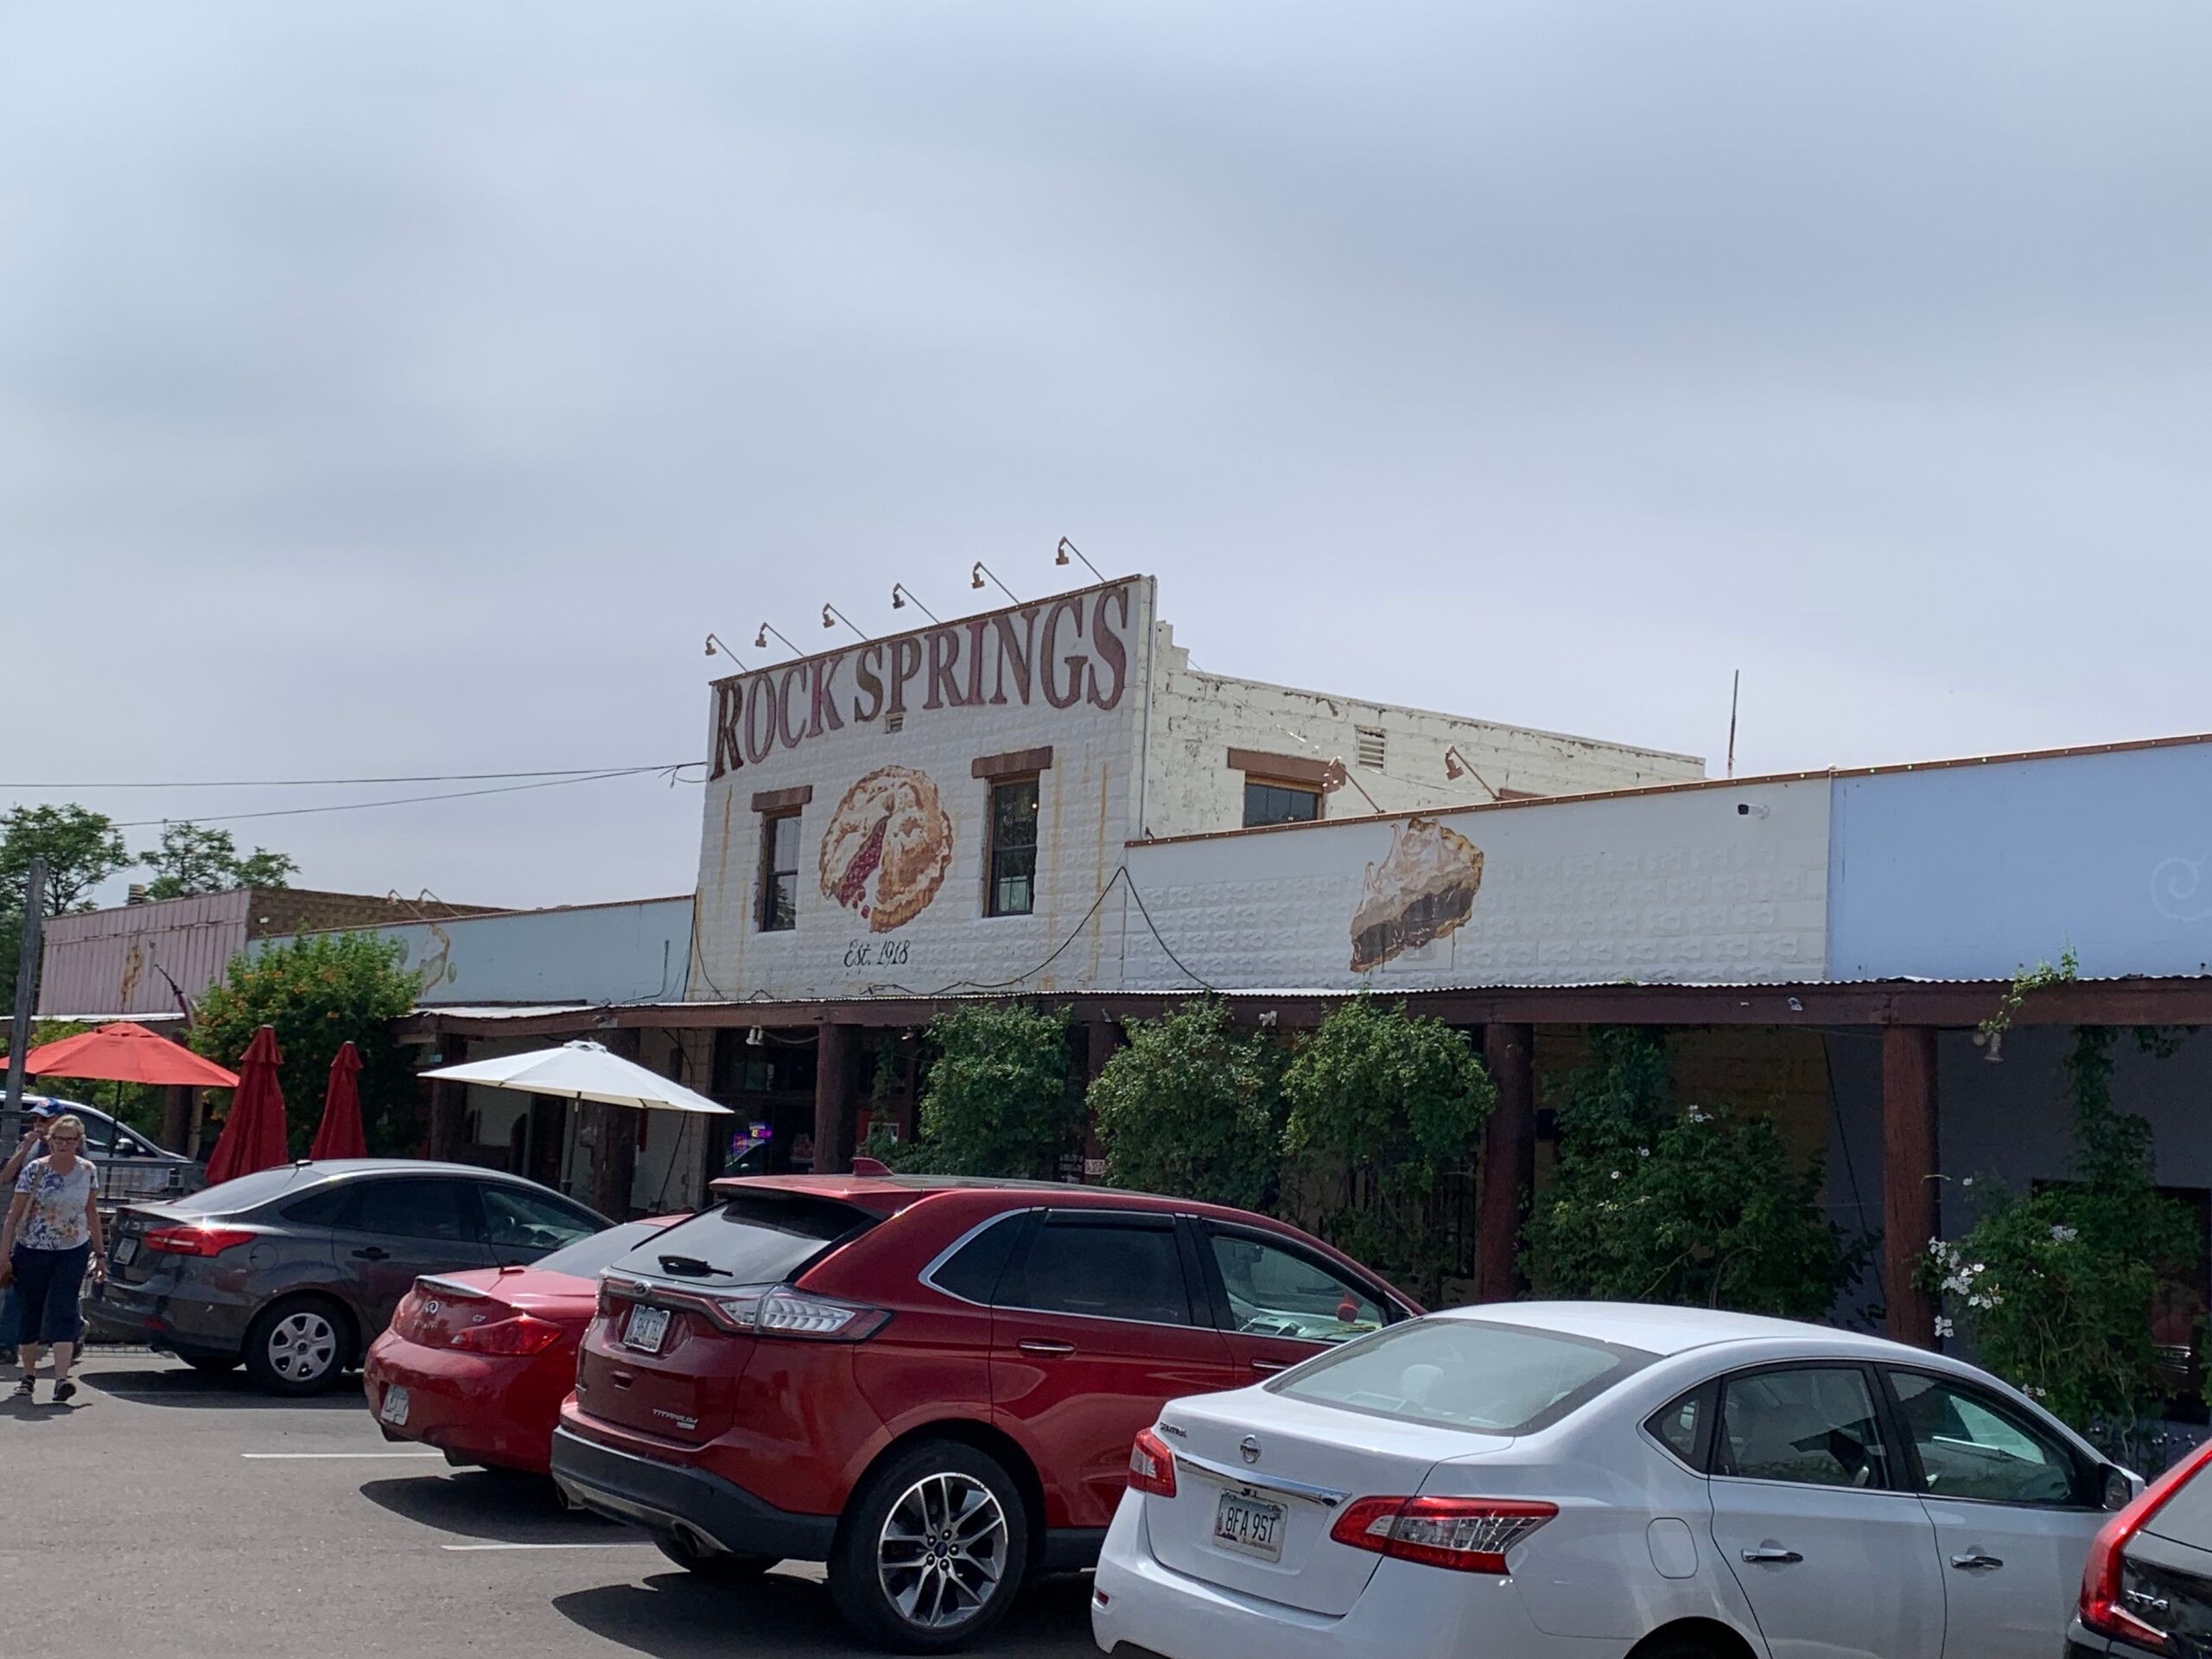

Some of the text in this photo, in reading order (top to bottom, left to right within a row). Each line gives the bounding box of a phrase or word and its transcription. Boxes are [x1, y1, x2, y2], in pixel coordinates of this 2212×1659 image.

[709, 586, 1128, 782] ROCK SPRINGS
[843, 938, 911, 969] Est. 1918
